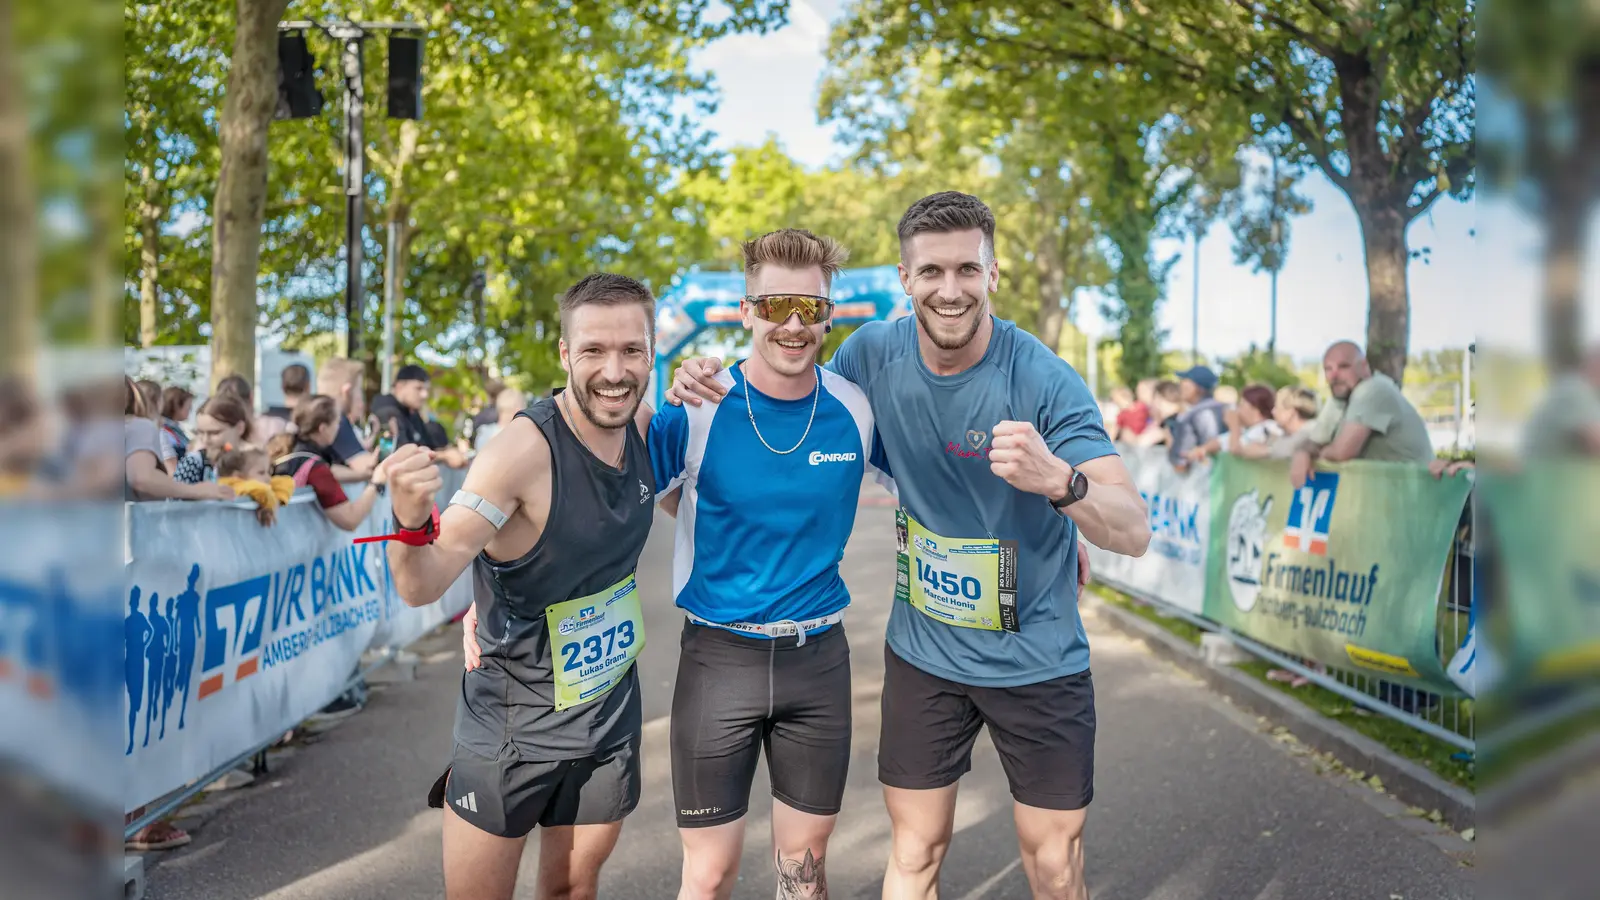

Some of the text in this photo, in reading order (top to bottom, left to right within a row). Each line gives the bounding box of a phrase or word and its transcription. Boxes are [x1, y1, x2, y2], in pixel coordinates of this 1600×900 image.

[808, 451, 857, 466] CONRAD
[272, 564, 305, 632] VR
[312, 543, 376, 617] BANK
[916, 556, 982, 600] 1450
[1267, 553, 1380, 606] Firmenlauf
[924, 587, 949, 605] Marcel
[950, 596, 976, 611] Honig
[576, 612, 605, 628] Firmenlauf
[1004, 607, 1012, 629] HILTL
[561, 620, 635, 672] 2373
[580, 664, 604, 678] Lukas
[605, 651, 627, 667] Graml
[681, 808, 712, 816] CRAFT
